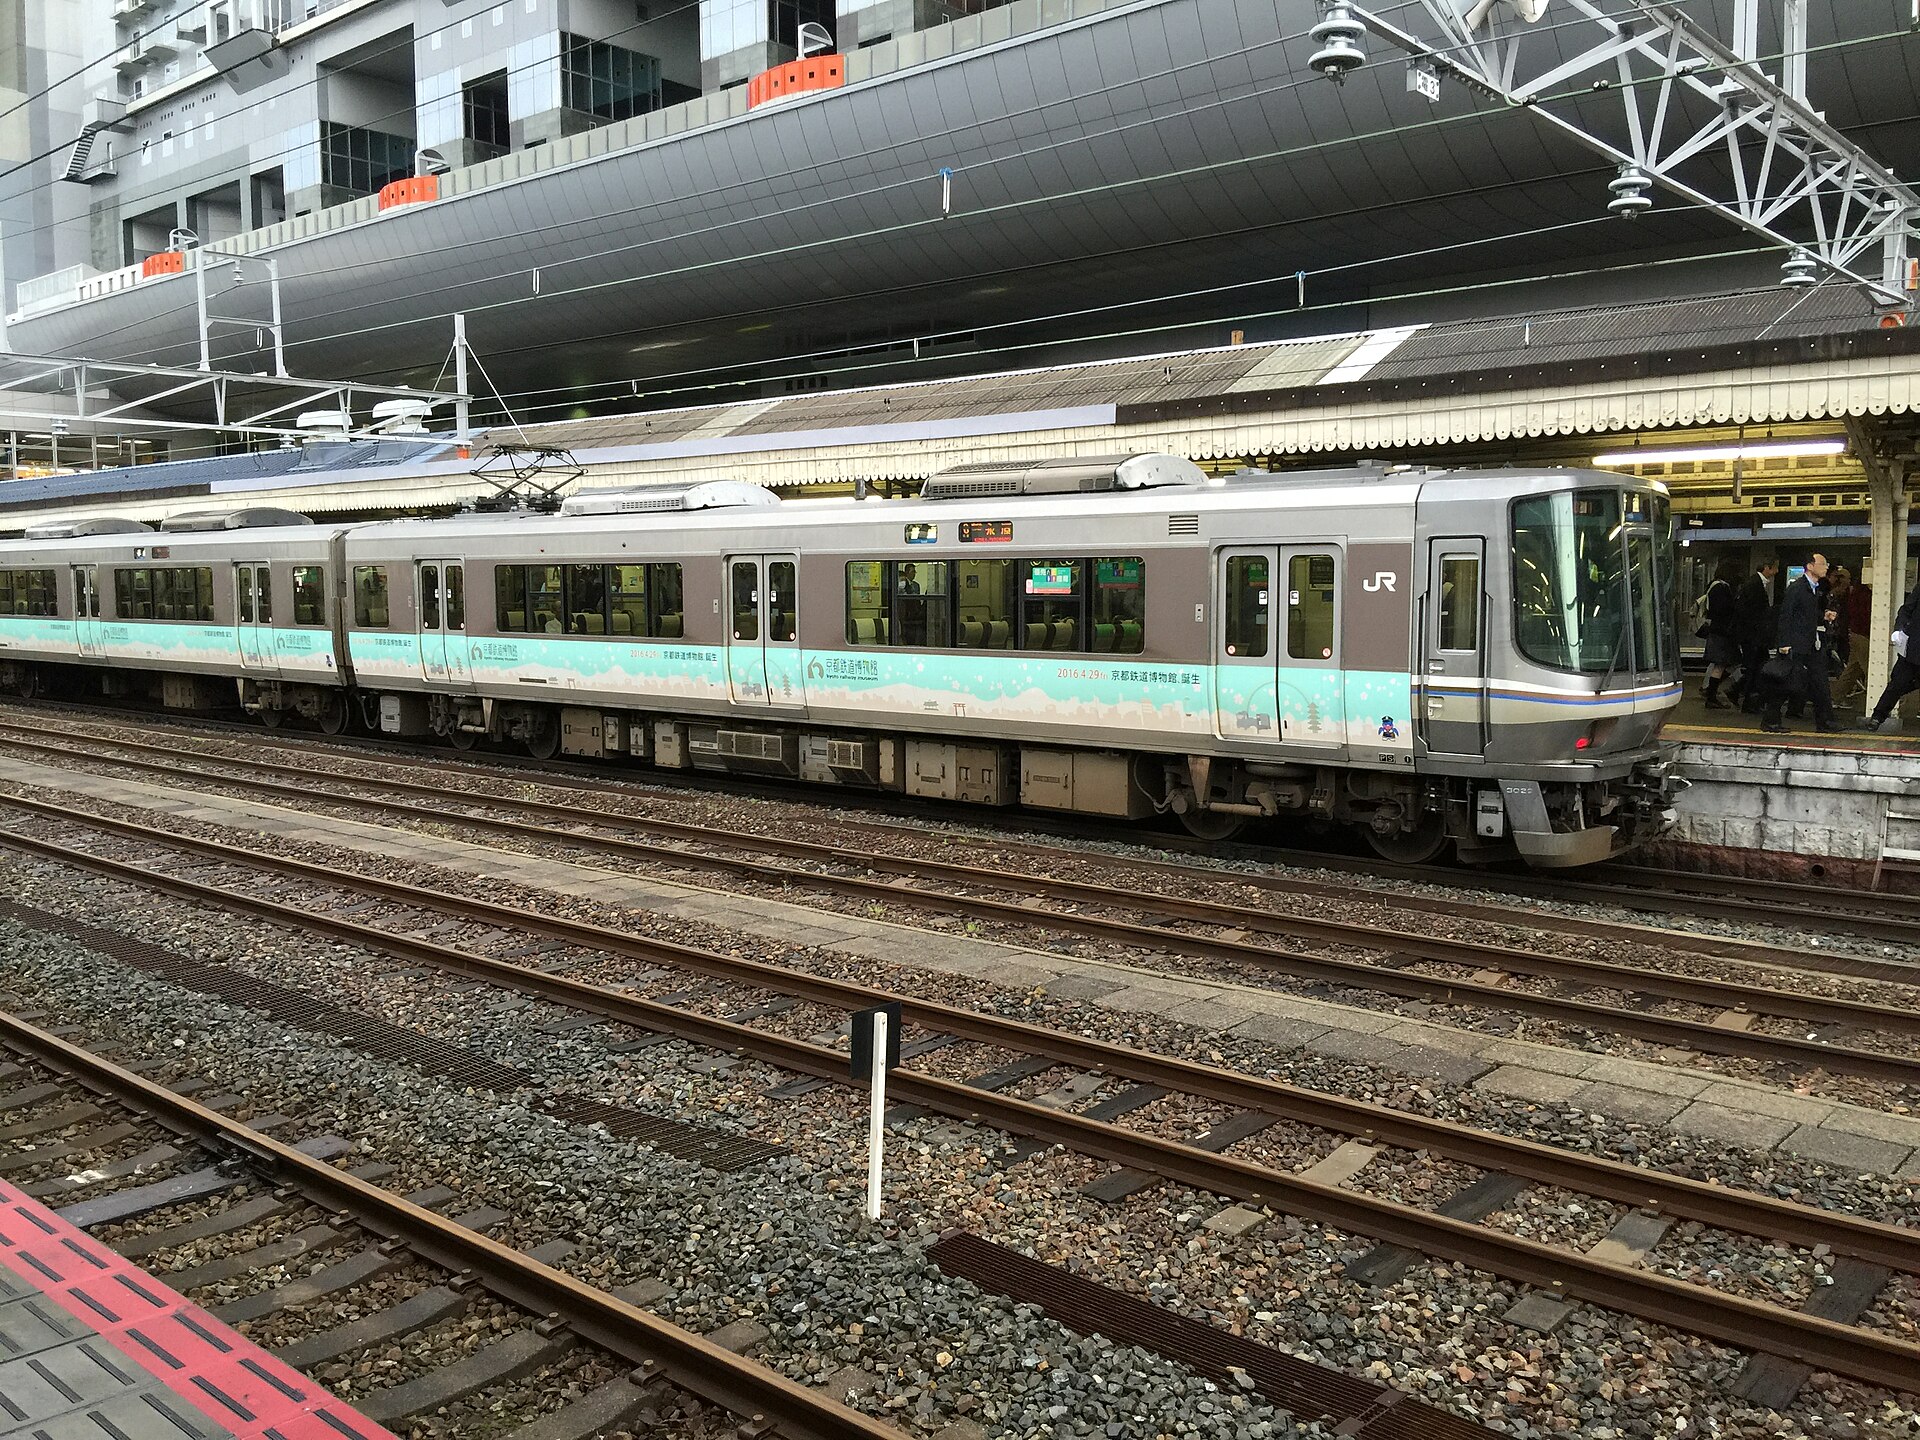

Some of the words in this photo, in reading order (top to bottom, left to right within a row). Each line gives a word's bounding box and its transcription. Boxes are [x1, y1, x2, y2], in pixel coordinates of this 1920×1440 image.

[1363, 571, 1397, 592] JR
[826, 658, 878, 676] 京都鉄道博物館
